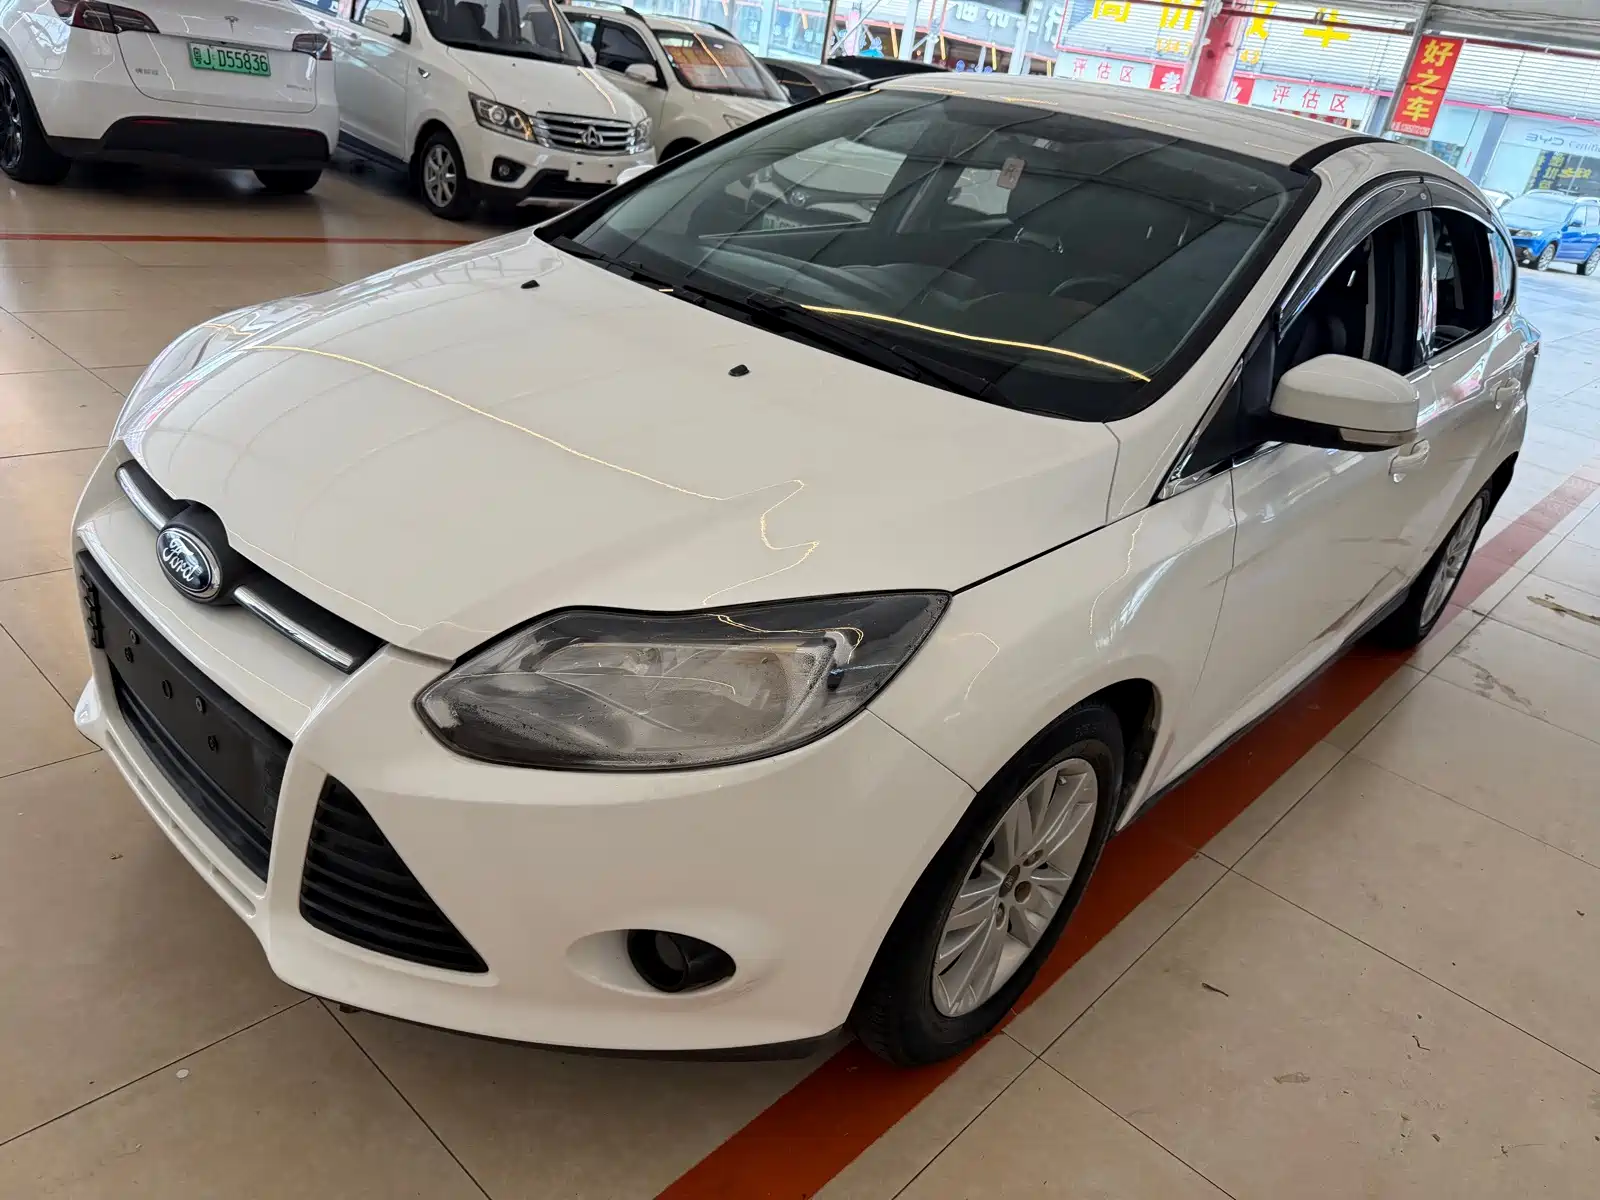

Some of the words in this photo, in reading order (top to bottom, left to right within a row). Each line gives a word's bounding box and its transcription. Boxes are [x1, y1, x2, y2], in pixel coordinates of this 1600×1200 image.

[1272, 84, 1349, 113] 评估区
[1402, 39, 1455, 122] 好之车
[1525, 132, 1564, 146] BYD
[162, 538, 199, 582] Ford
